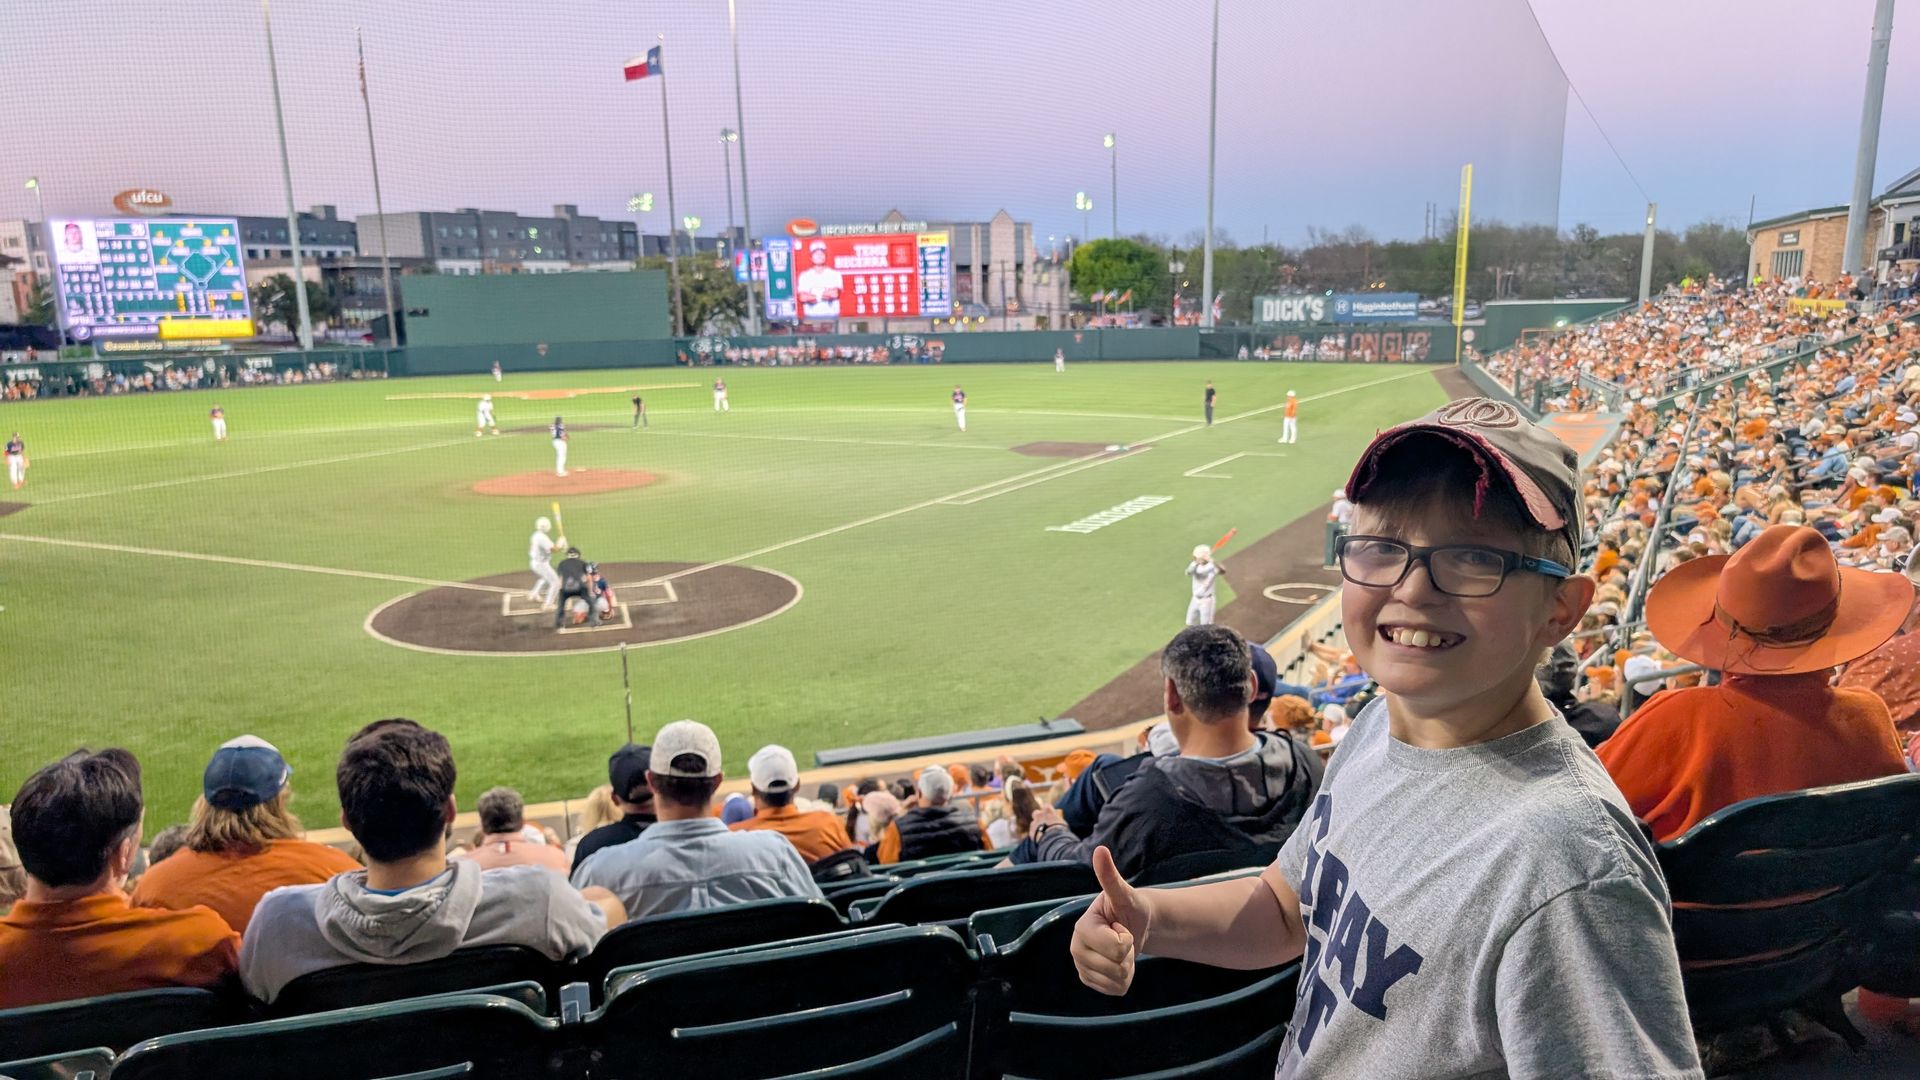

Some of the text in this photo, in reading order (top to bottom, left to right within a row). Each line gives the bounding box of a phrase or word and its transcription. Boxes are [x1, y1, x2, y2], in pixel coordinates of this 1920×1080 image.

[131, 190, 163, 204] ufcu
[1262, 295, 1324, 321] DICK'S
[1352, 301, 1416, 313] Higginbotham
[245, 356, 273, 369] YETI
[6, 368, 40, 381] YETI
